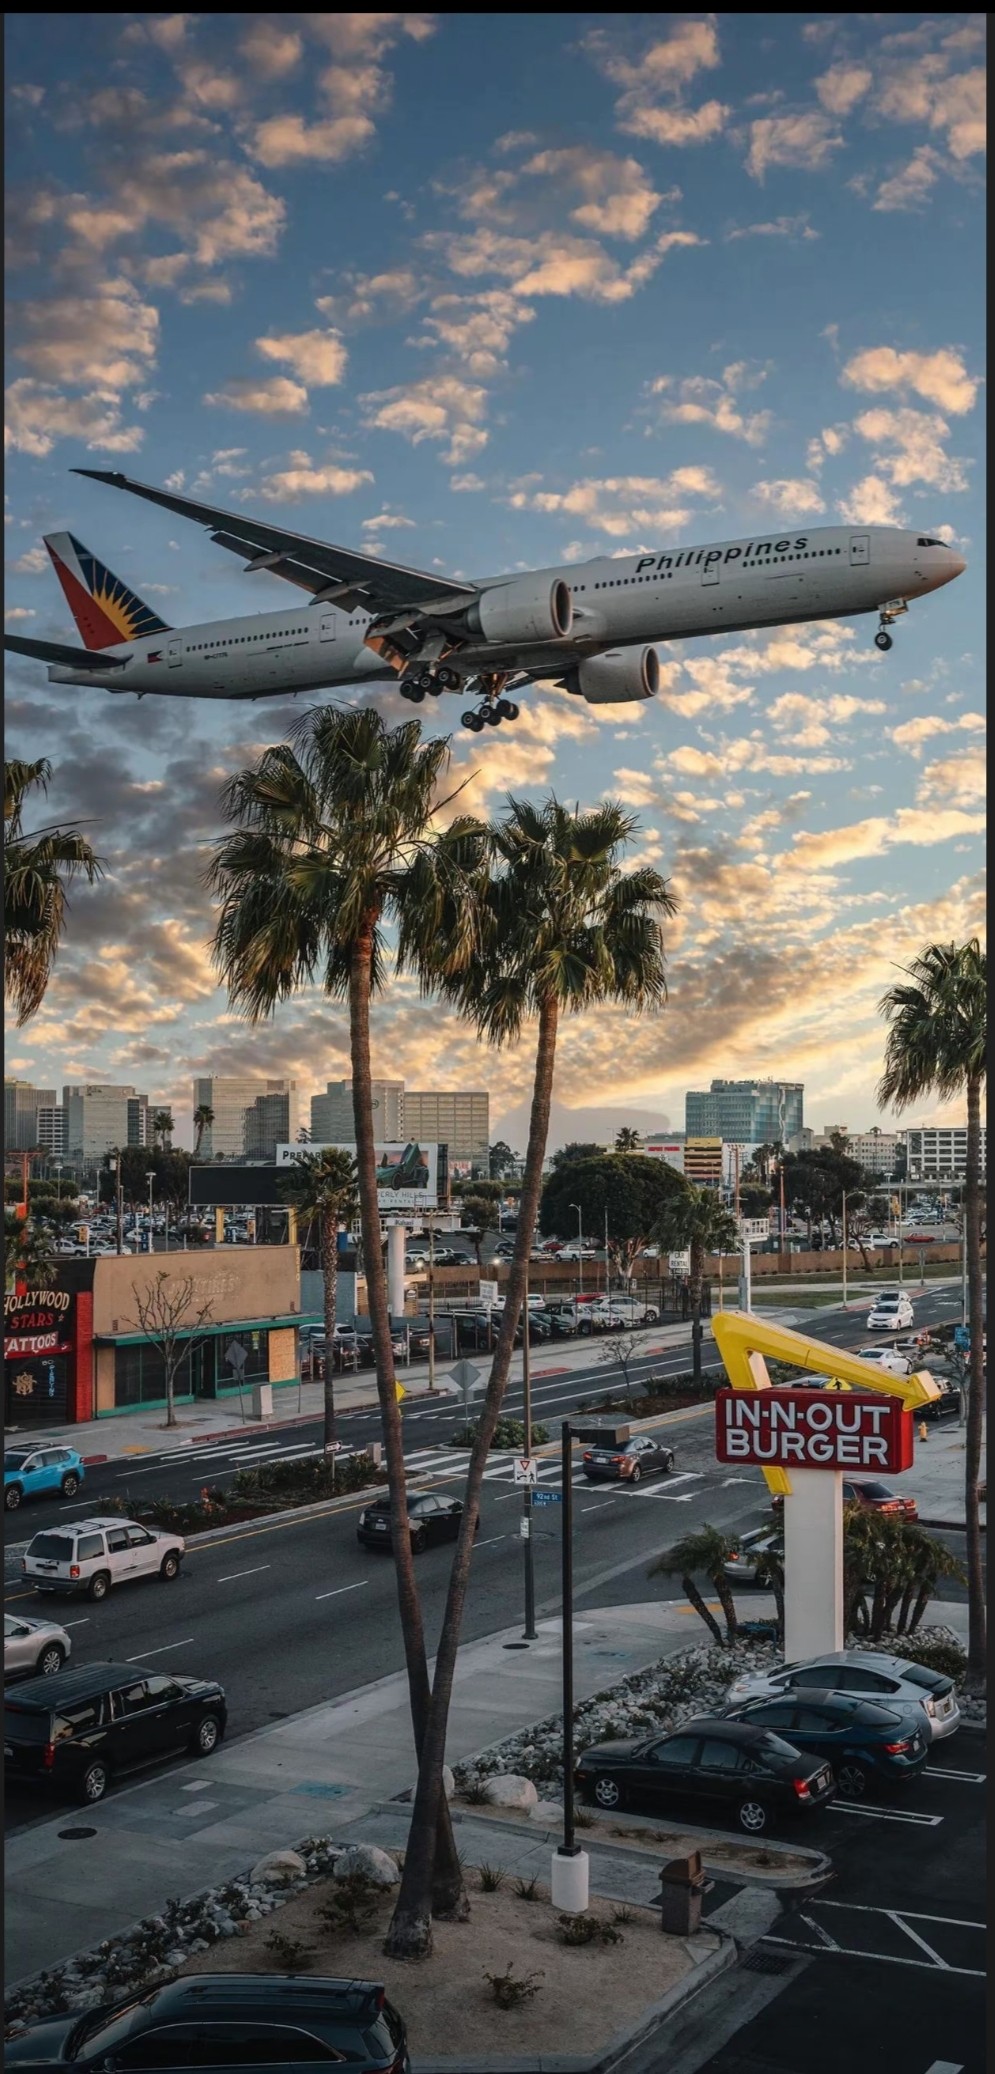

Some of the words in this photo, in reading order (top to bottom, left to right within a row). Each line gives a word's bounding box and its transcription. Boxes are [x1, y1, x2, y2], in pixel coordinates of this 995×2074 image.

[635, 537, 808, 573] Philippines
[282, 1151, 322, 1160] PREAR
[10, 1312, 54, 1329] STARS
[4, 1333, 56, 1352] ATTOOS
[725, 1399, 891, 1434] IN-N-OUT
[726, 1428, 889, 1466] BURGER
